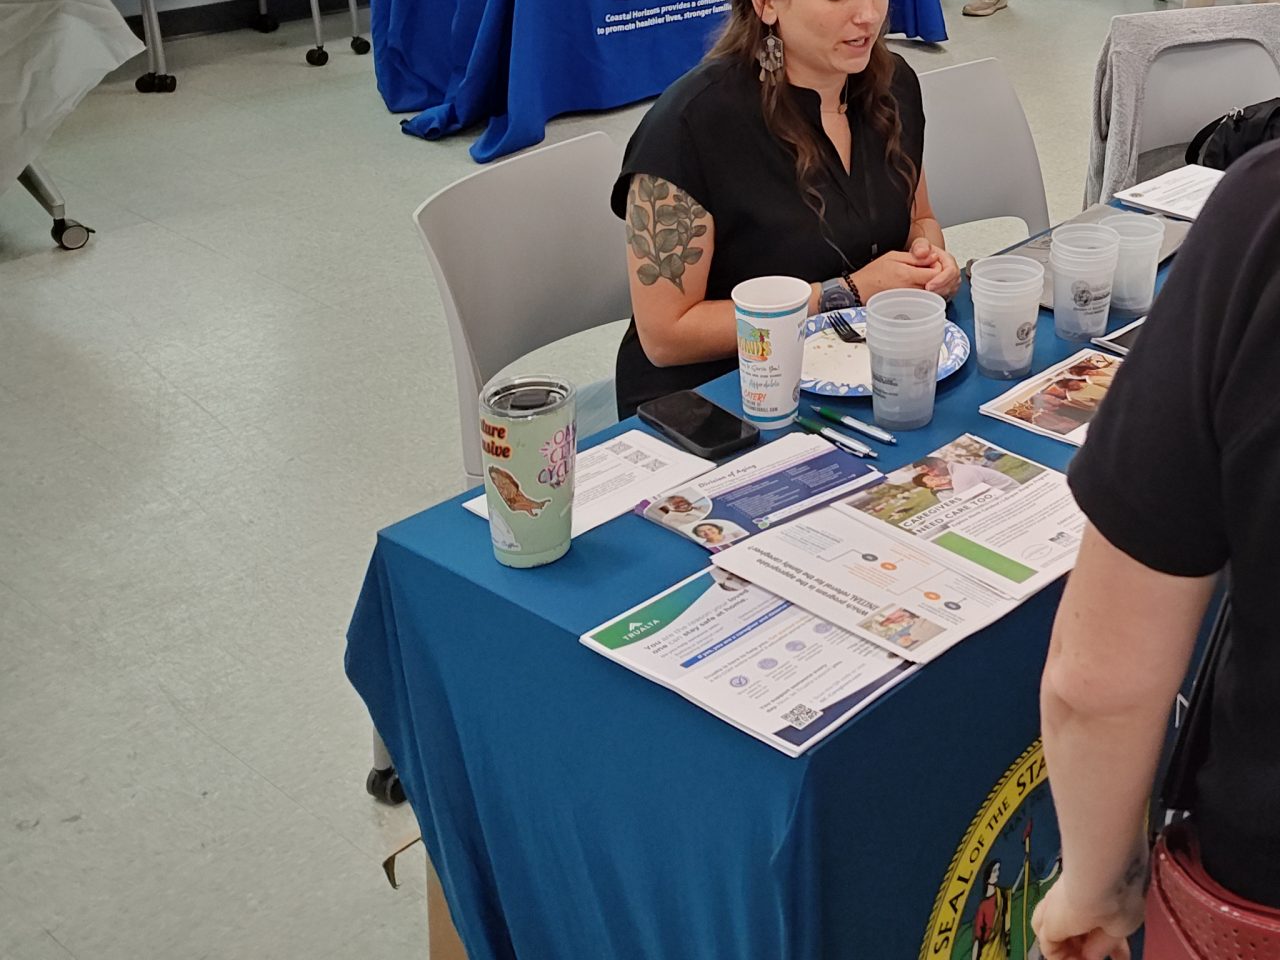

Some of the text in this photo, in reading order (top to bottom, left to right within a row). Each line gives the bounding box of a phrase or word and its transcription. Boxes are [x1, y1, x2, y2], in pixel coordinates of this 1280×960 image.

[597, 27, 605, 35] to
[605, 22, 635, 35] promote
[636, 16, 665, 29] healthier
[665, 14, 683, 23] lives,
[684, 7, 712, 19] stronger
[605, 11, 632, 22] Coastal
[632, 7, 660, 18] Horizons
[661, 0, 690, 14] provides
[480, 419, 506, 439] ture
[698, 476, 727, 488] Division
[736, 465, 757, 474] Aging
[903, 497, 962, 527] CAREGIVERS
[916, 518, 944, 533] NEED
[945, 504, 970, 519] CARE
[747, 545, 783, 563] caregiver?
[756, 559, 796, 580] appropriate
[782, 561, 803, 574] family
[802, 571, 815, 580] the
[795, 578, 809, 587] the
[823, 582, 851, 597] referral
[815, 587, 847, 605] program
[850, 594, 879, 611] INITIAL
[845, 603, 869, 616] Which
[622, 619, 660, 640] TRUALTA
[652, 644, 669, 654] one
[682, 626, 700, 637] stay
[699, 616, 716, 626] safe
[644, 640, 661, 650] You
[933, 869, 975, 955] SEAL
[969, 837, 985, 864] OF
[986, 796, 1011, 831] THE
